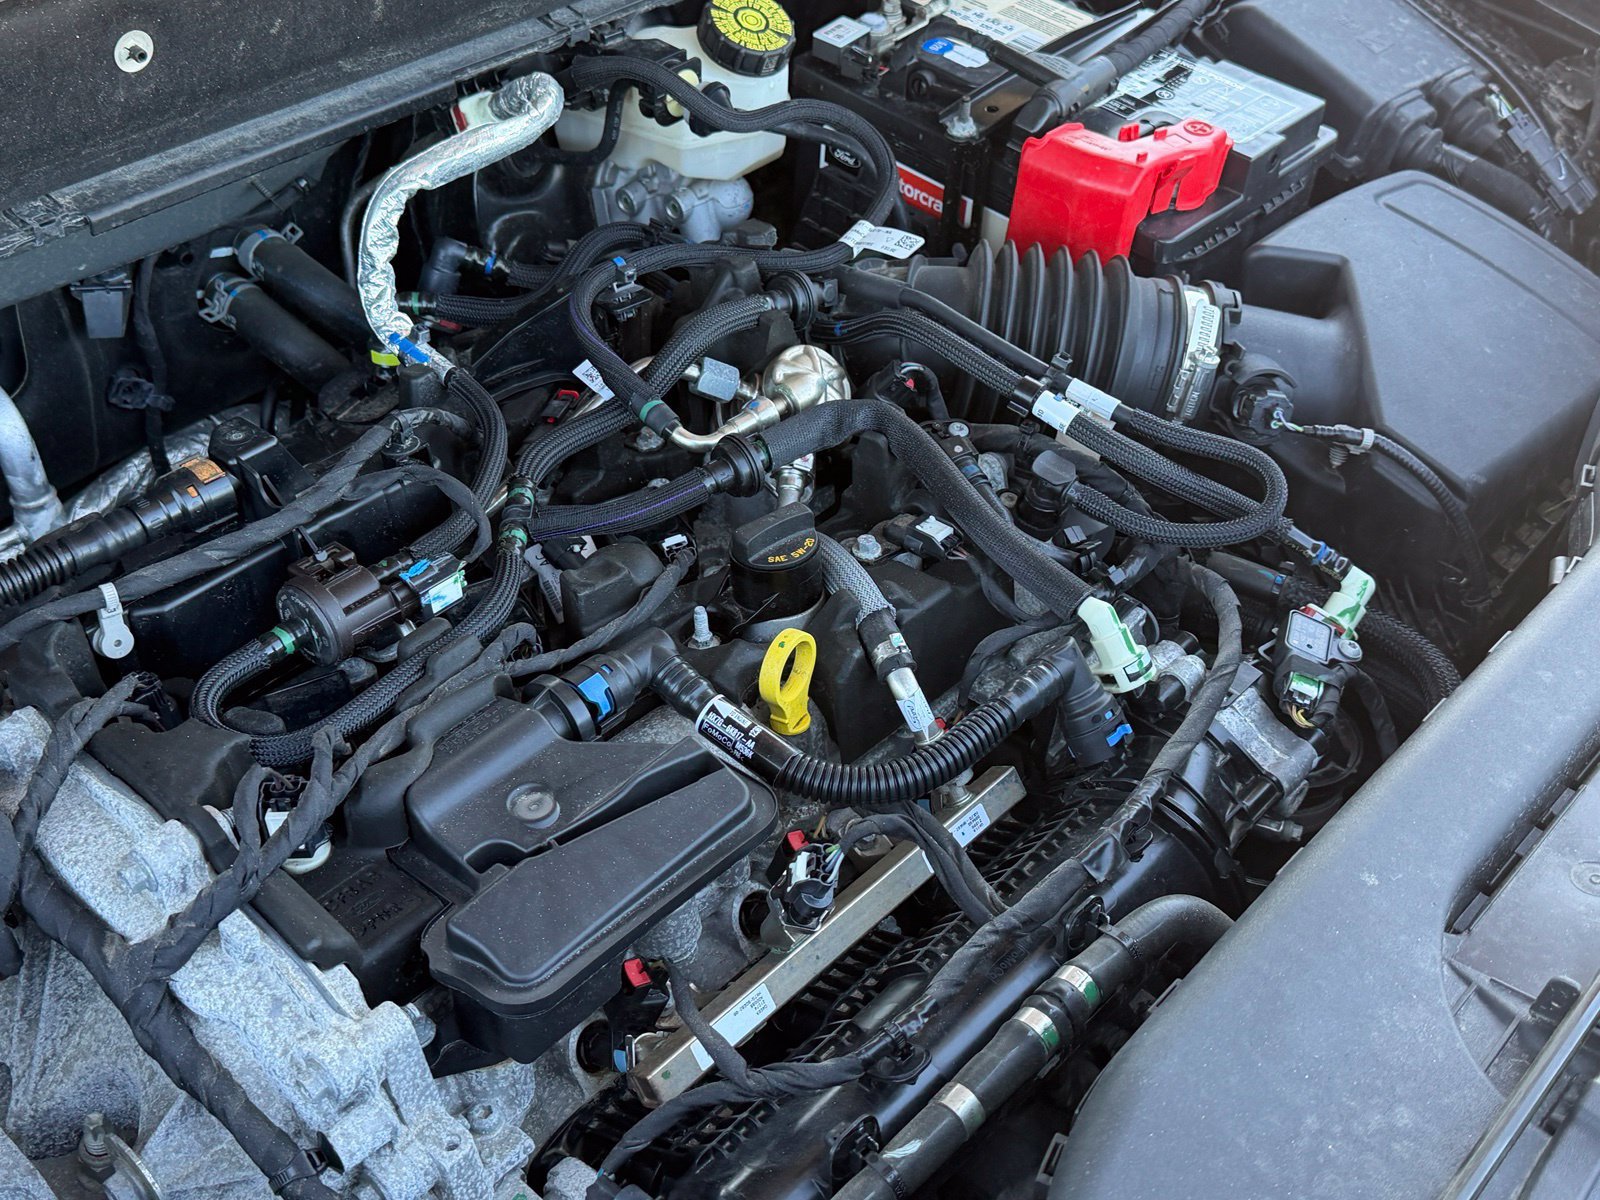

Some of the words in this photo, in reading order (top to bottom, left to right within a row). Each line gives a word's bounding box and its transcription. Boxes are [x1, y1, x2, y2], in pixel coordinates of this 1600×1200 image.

[834, 148, 857, 166] Ford
[898, 176, 943, 214] torcra
[767, 554, 788, 563] SAE
[790, 537, 815, 559] 5W-20
[702, 723, 733, 748] FoMoCo
[989, 945, 1026, 980] FoMoCo
